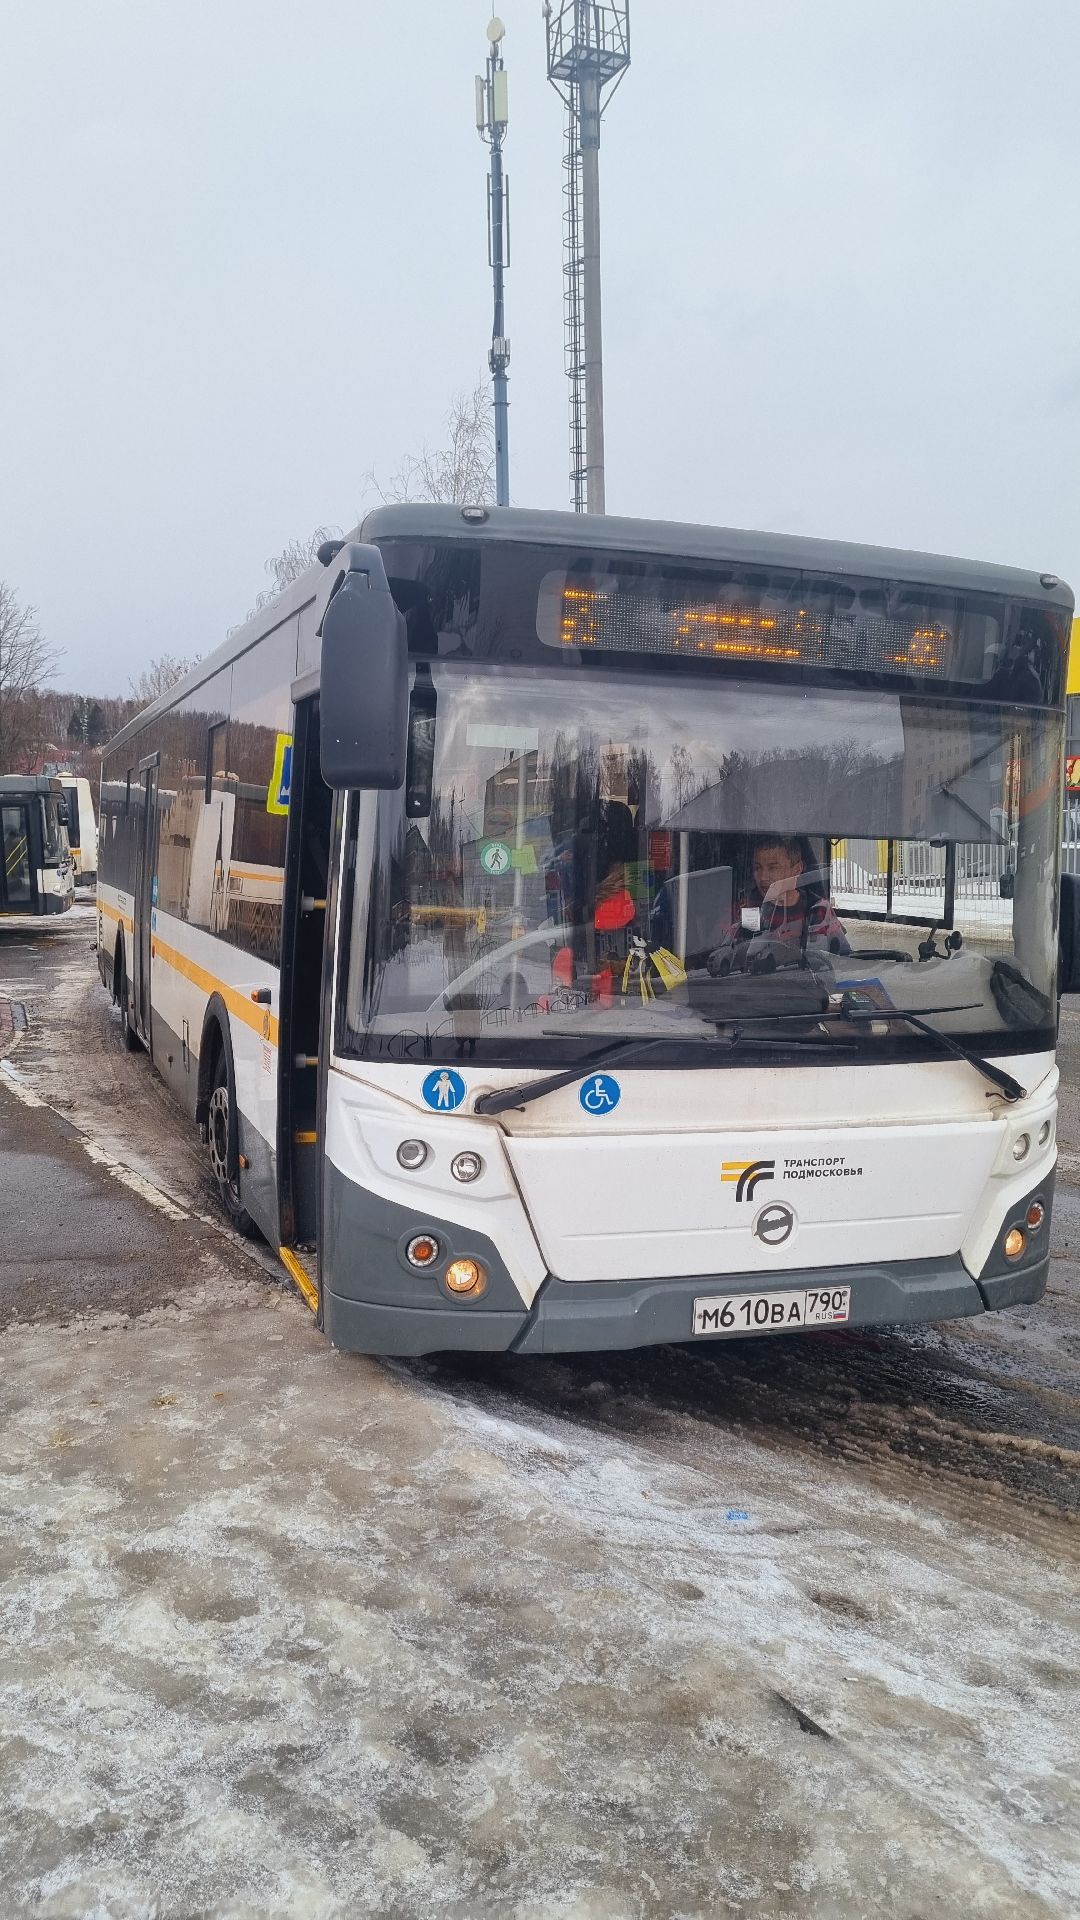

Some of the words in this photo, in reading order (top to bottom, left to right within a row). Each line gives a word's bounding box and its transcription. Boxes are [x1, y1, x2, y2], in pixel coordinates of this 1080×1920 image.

[784, 1157, 845, 1167] ТРАНСПОРТ
[783, 1168, 863, 1179] ПОДМОСКОВЬЯ
[702, 1299, 801, 1329] М610ВА
[808, 1291, 843, 1313] 790
[815, 1312, 833, 1320] RUS
